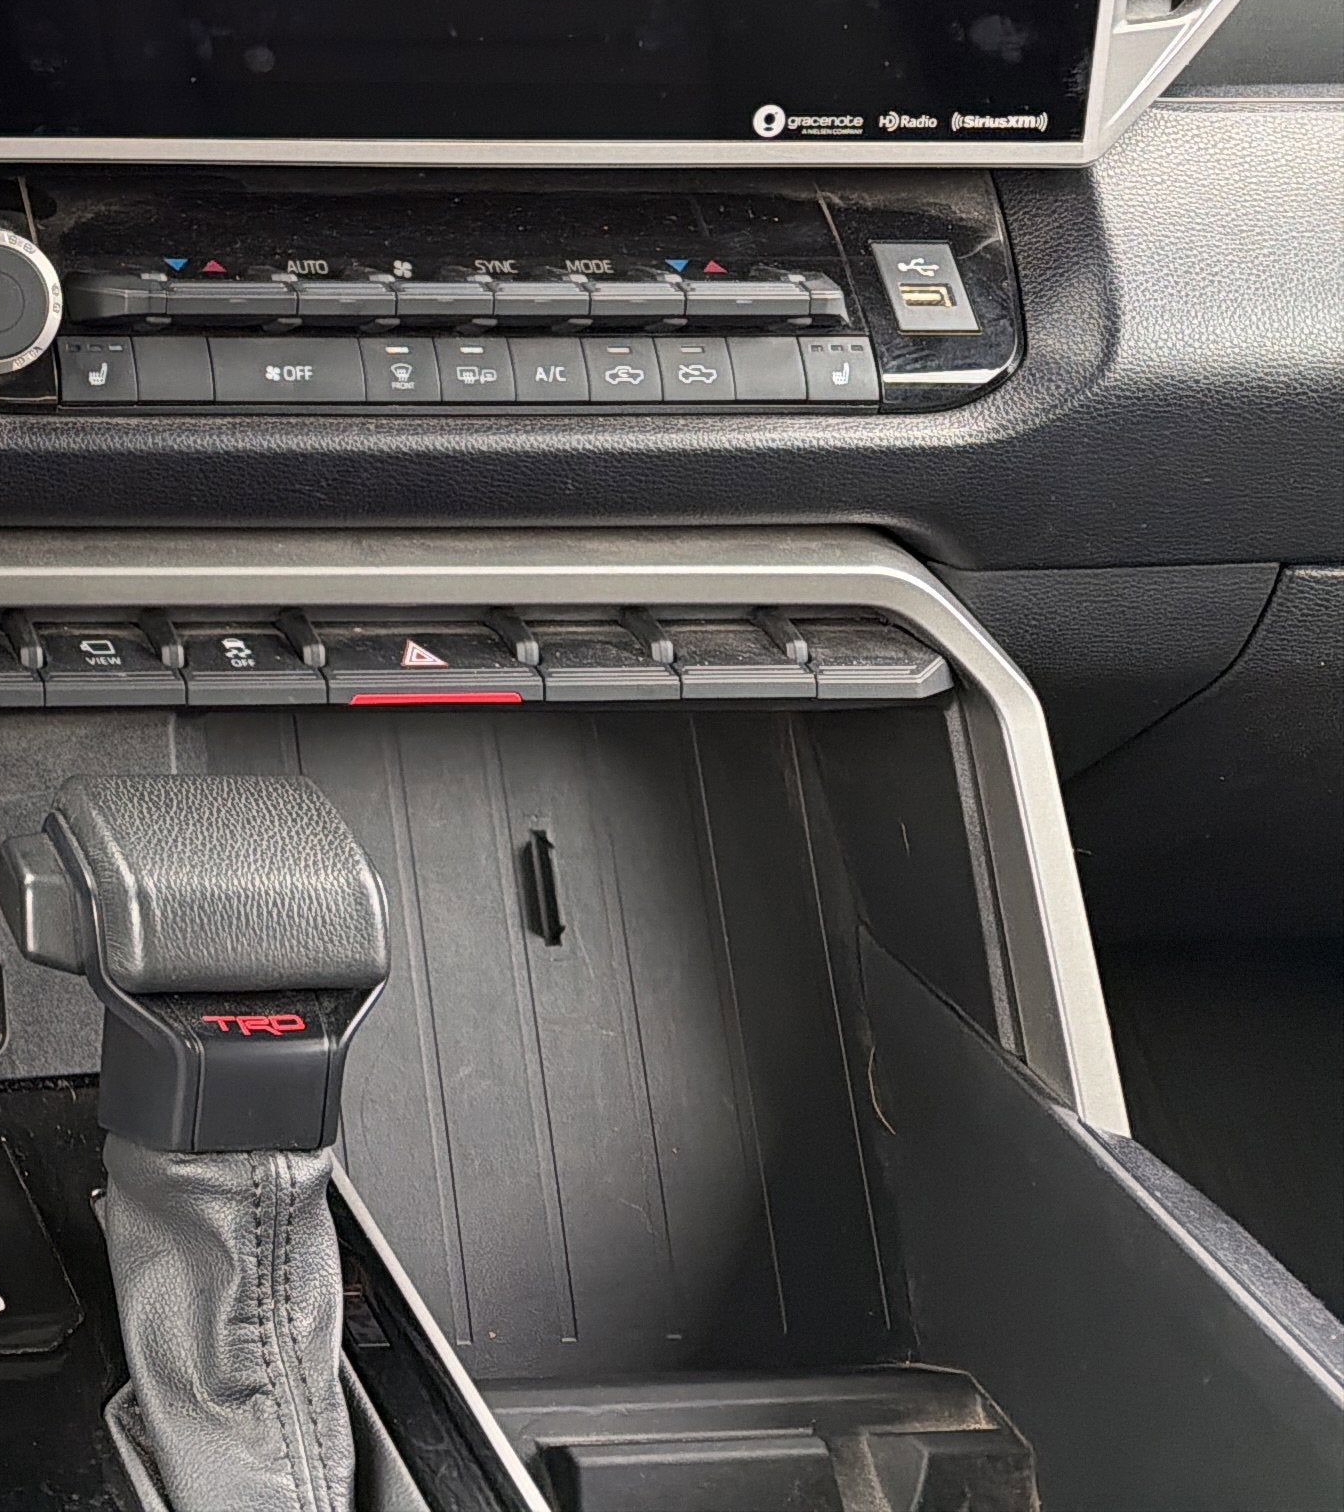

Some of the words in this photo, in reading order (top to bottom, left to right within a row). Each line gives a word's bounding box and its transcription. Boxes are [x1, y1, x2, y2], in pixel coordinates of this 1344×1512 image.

[787, 115, 864, 129] gracenote
[900, 114, 938, 128] Radio
[287, 260, 329, 275] AUTO
[474, 259, 520, 274] SYNC
[566, 259, 614, 274] MODE
[283, 365, 313, 381] OFF
[535, 365, 567, 382] A/C
[391, 381, 415, 389] FRONT
[85, 656, 122, 666] VIEW
[230, 658, 256, 668] OFF
[201, 1014, 306, 1036] TRD
